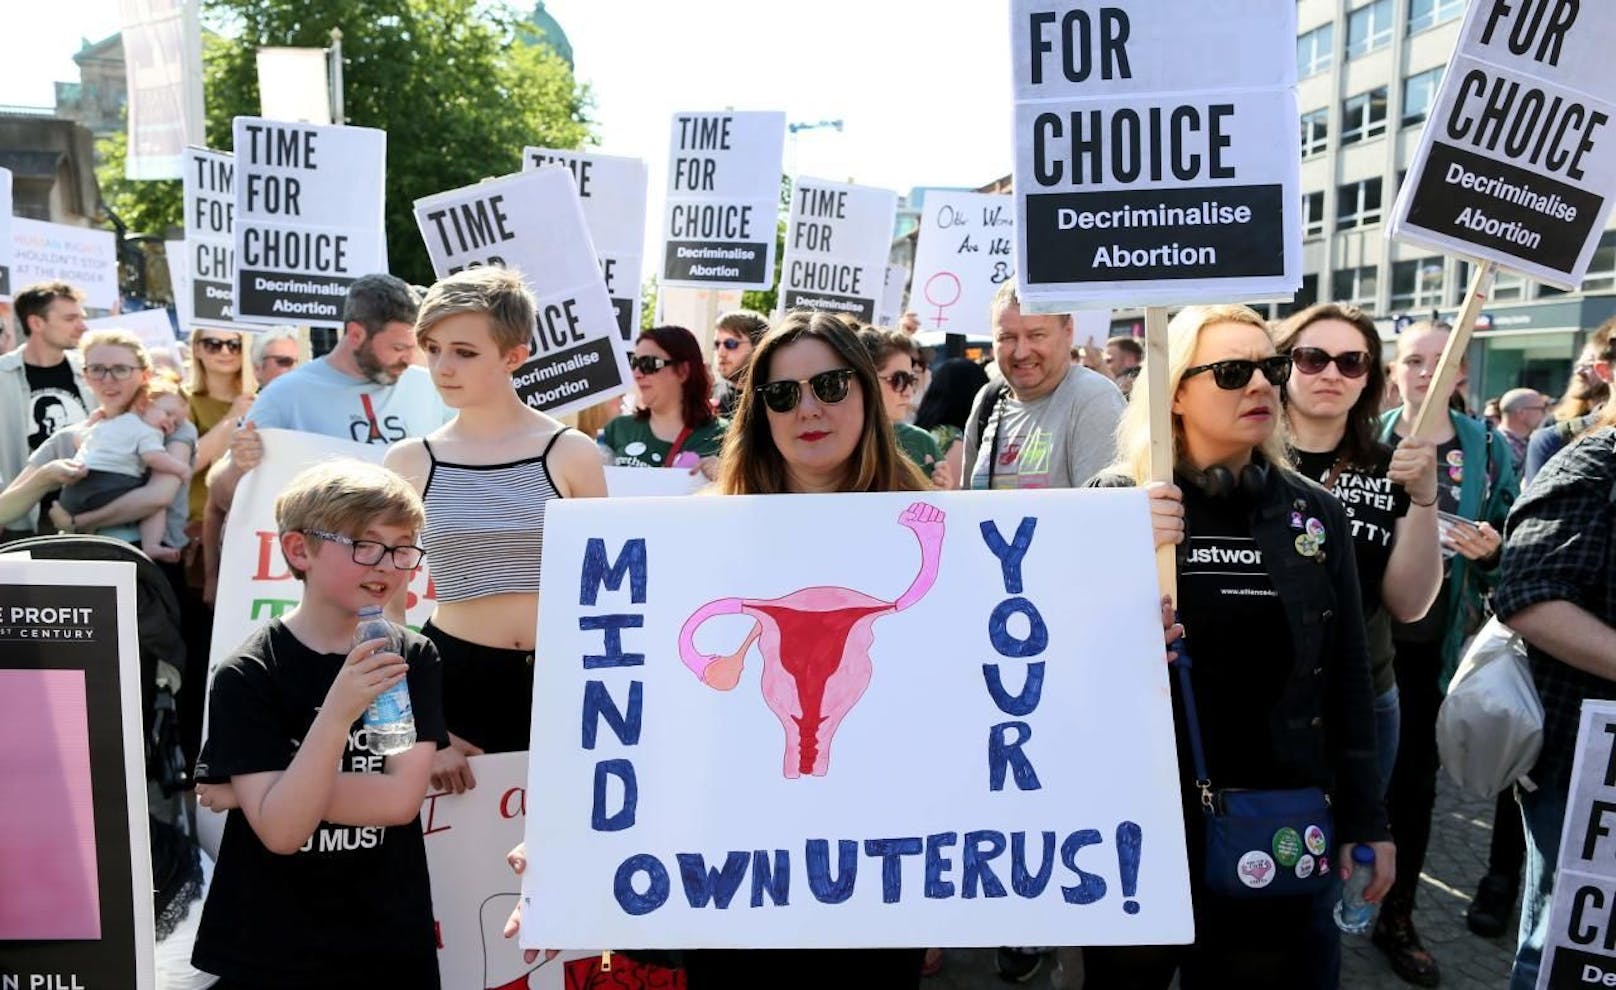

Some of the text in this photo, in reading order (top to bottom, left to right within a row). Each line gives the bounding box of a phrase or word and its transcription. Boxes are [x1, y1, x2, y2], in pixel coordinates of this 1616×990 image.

[1030, 7, 1132, 84] FOR
[1480, 0, 1580, 67] FOR
[678, 117, 732, 150] TIME
[1447, 69, 1609, 181] CHOICE
[246, 125, 318, 170] TIME
[1033, 103, 1235, 187] CHOICE
[675, 158, 716, 191] FOR
[247, 174, 301, 216] FOR
[799, 187, 848, 219] TIME
[1445, 162, 1578, 223] Decriminalise
[427, 194, 515, 257] TIME
[671, 205, 753, 240] CHOICE
[1057, 202, 1252, 230] Decriminalise
[1454, 206, 1541, 249] Abortion
[243, 227, 349, 273] CHOICE
[677, 246, 755, 261] Decriminalise
[795, 222, 832, 252] FOR
[689, 264, 739, 278] Abortion
[1092, 243, 1216, 268] Abortion
[790, 260, 863, 295] CHOICE
[273, 299, 337, 315] Abortion
[795, 296, 864, 312] Decriminalise
[511, 351, 600, 389] ecriminalise
[526, 379, 589, 407] Abortion
[10, 607, 93, 624] PROFIT
[20, 629, 94, 639] CENTURY
[979, 516, 1049, 792] YOUR
[579, 537, 648, 832] MIND
[613, 820, 1142, 916] OWN UTERUS!
[29, 973, 86, 990] PILL
